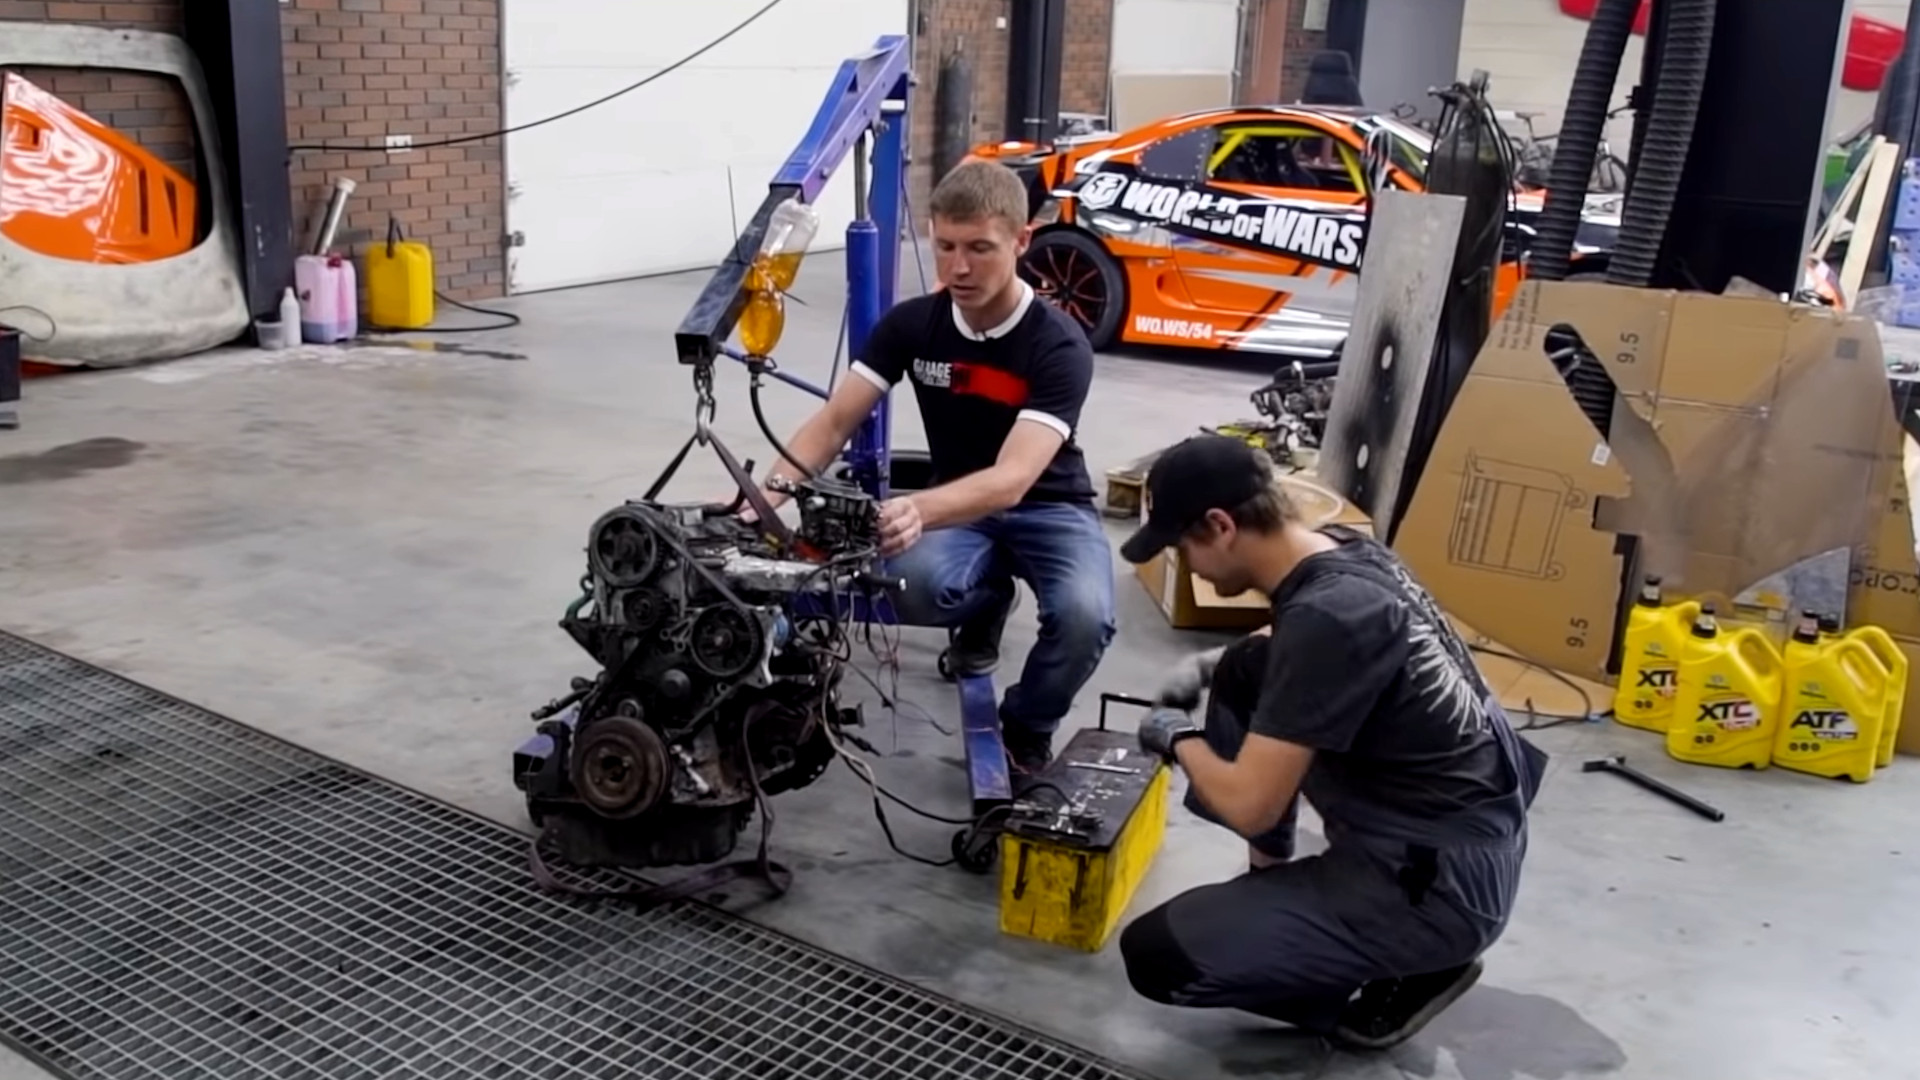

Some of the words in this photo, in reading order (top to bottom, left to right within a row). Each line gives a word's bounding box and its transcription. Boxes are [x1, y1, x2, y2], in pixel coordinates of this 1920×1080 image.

[1121, 181, 1240, 235] WORLD
[1232, 213, 1263, 241] OF
[1260, 204, 1363, 267] WARS
[1135, 315, 1213, 340] WO.WS/54
[1616, 332, 1640, 364] 9.5
[1565, 616, 1589, 649] 9.5
[1696, 700, 1752, 722] XTC
[1789, 711, 1850, 729] ATF
